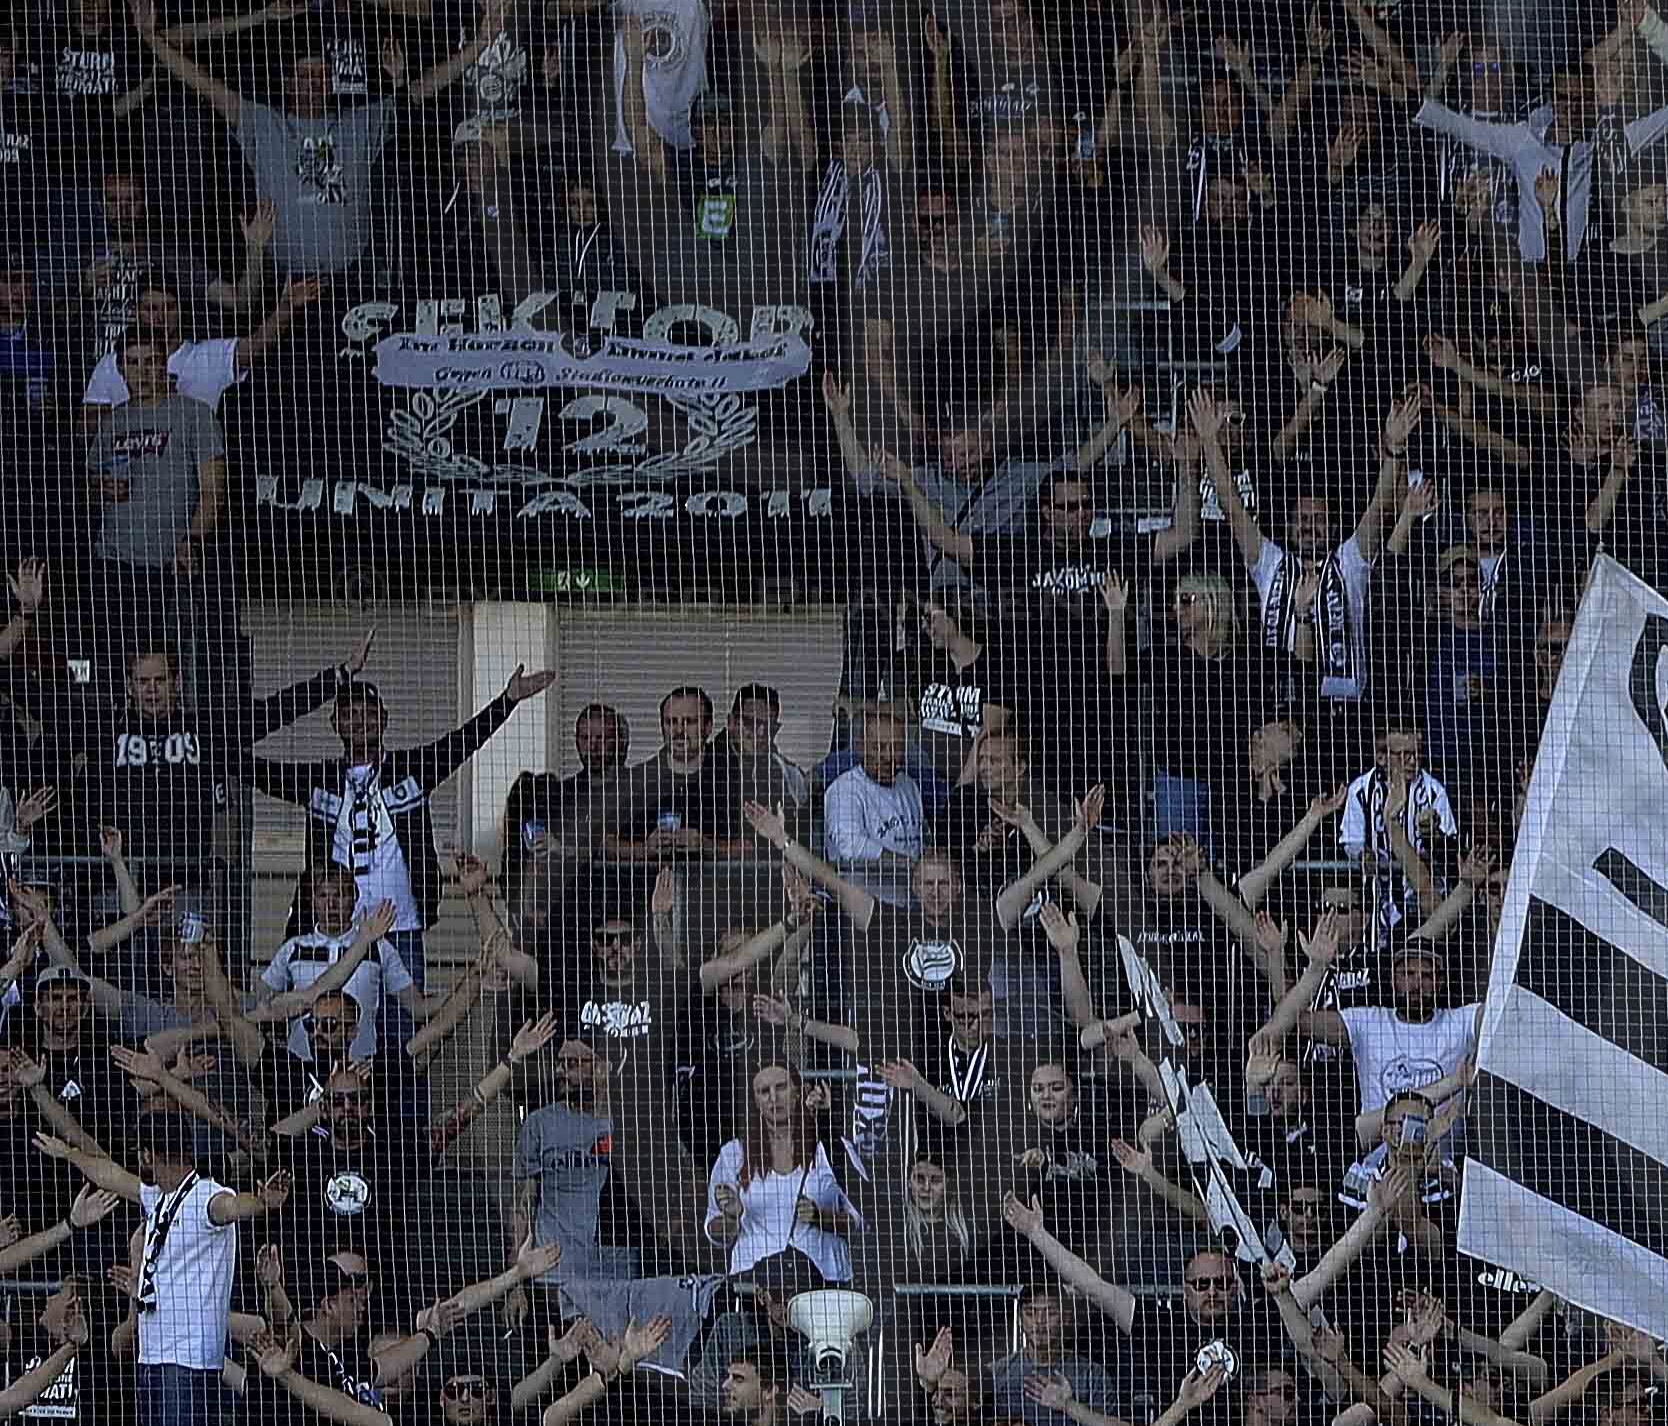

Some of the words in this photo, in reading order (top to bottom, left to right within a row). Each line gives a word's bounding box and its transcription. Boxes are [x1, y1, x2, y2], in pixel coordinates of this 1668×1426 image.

[493, 393, 649, 458] 12
[255, 474, 593, 518] UNITA
[616, 487, 834, 519] 2011
